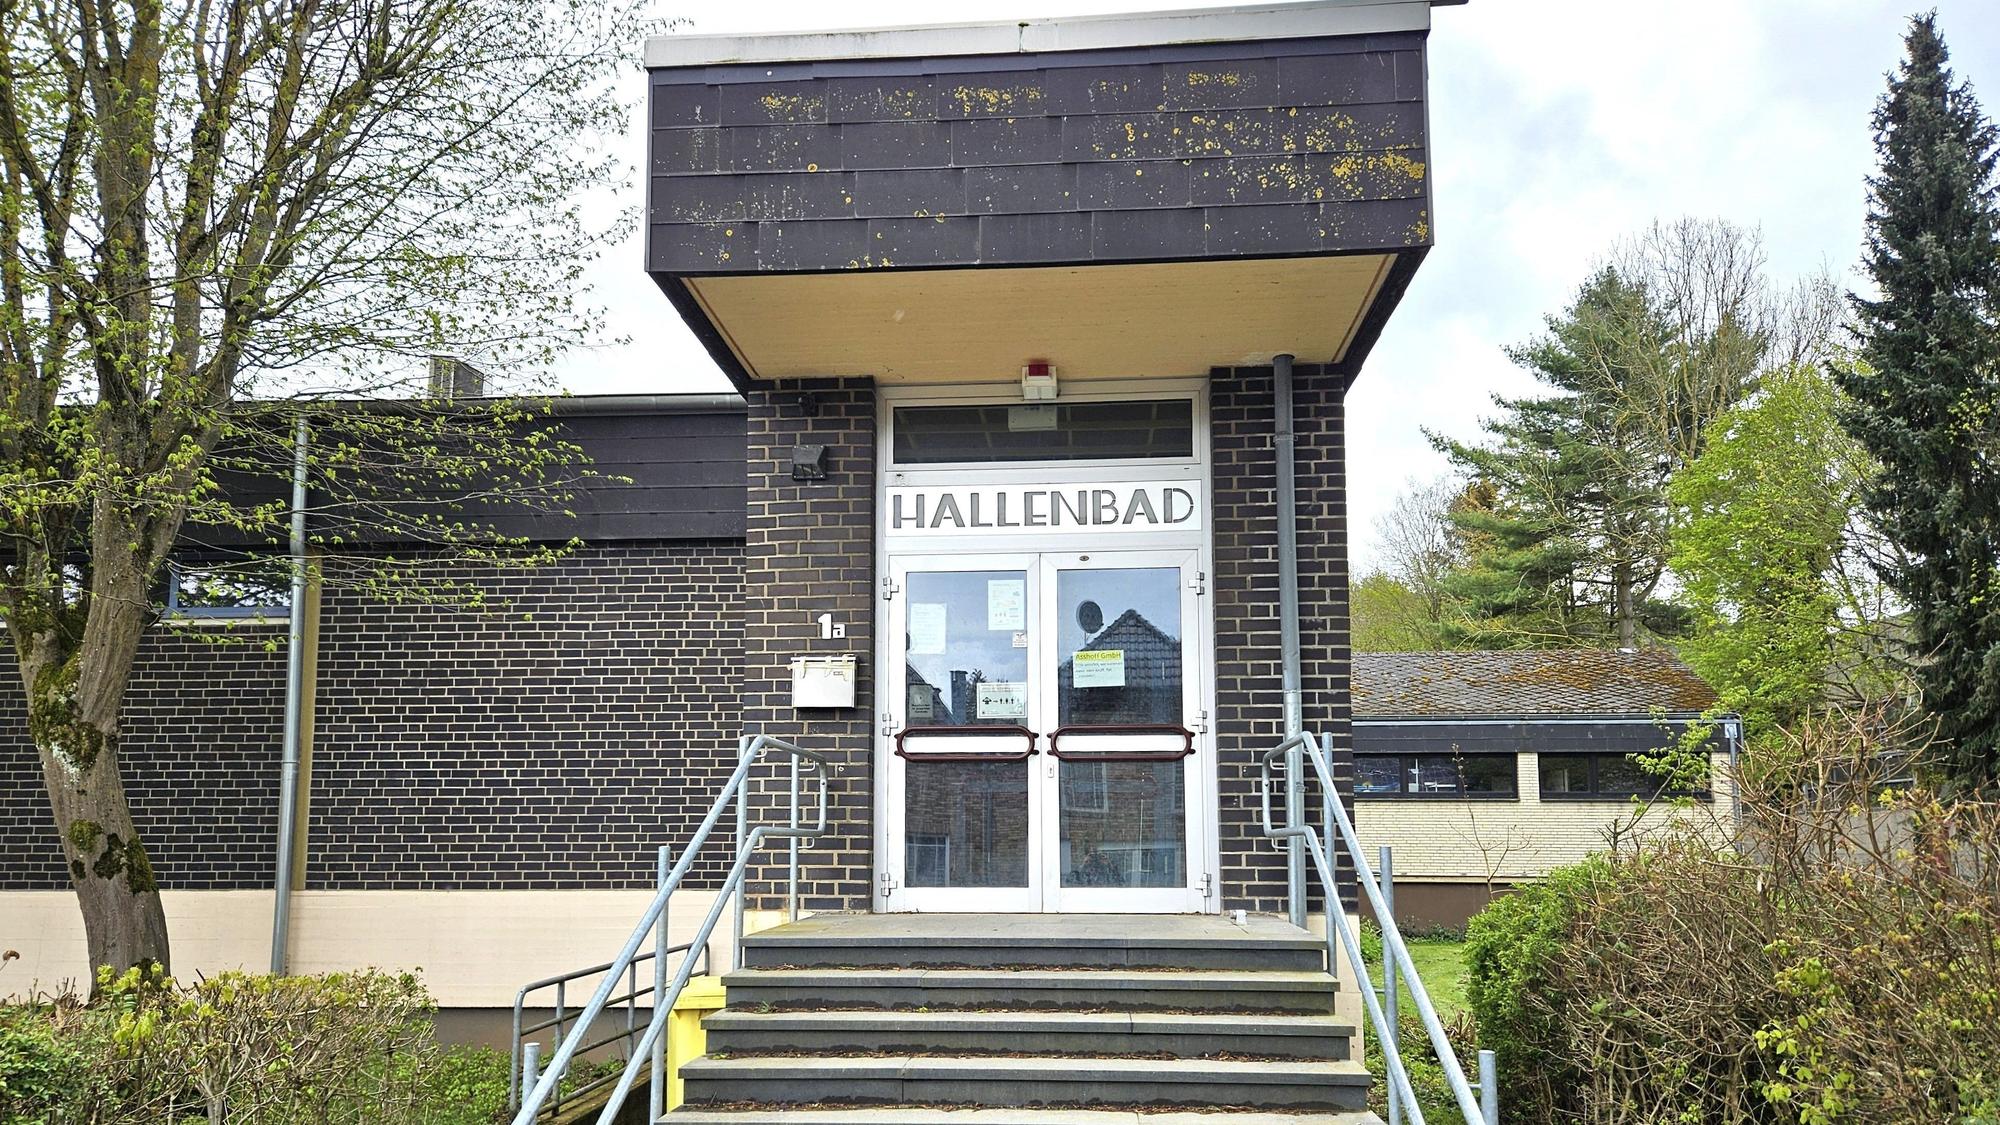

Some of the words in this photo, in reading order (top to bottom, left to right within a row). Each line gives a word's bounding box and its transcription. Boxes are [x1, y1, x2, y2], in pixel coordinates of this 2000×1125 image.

[893, 488, 1194, 529] HALLENBAD
[817, 613, 846, 640] 1a
[1101, 651, 1121, 659] GmbH
